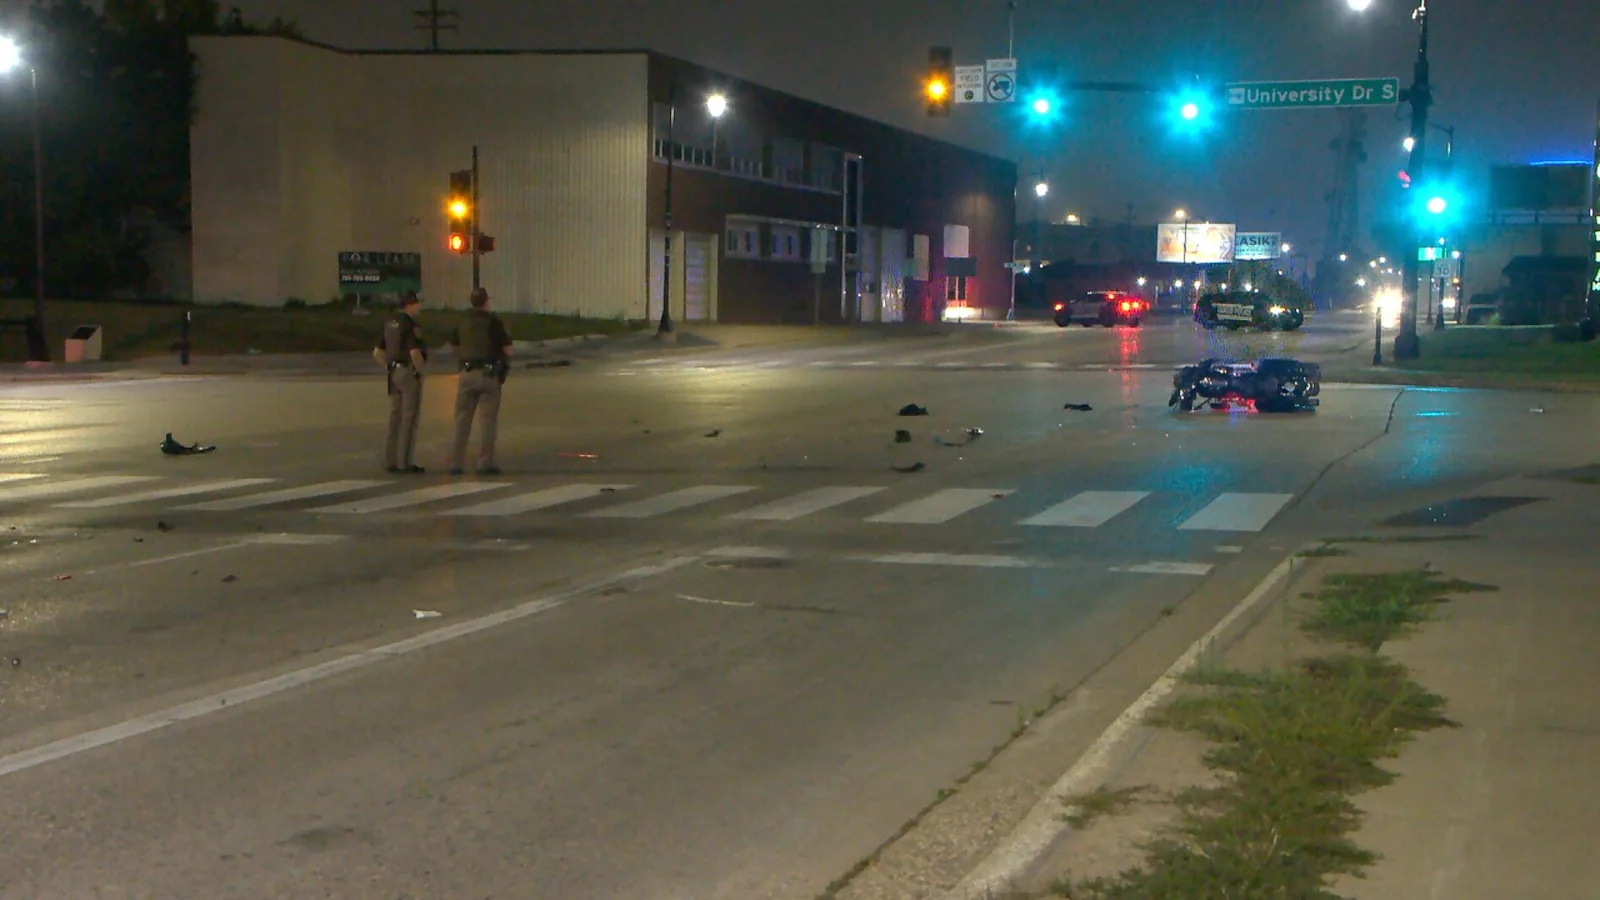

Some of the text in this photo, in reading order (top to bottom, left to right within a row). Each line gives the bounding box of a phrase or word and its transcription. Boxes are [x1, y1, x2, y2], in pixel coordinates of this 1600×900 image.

[1247, 83, 1394, 105] University Dr S
